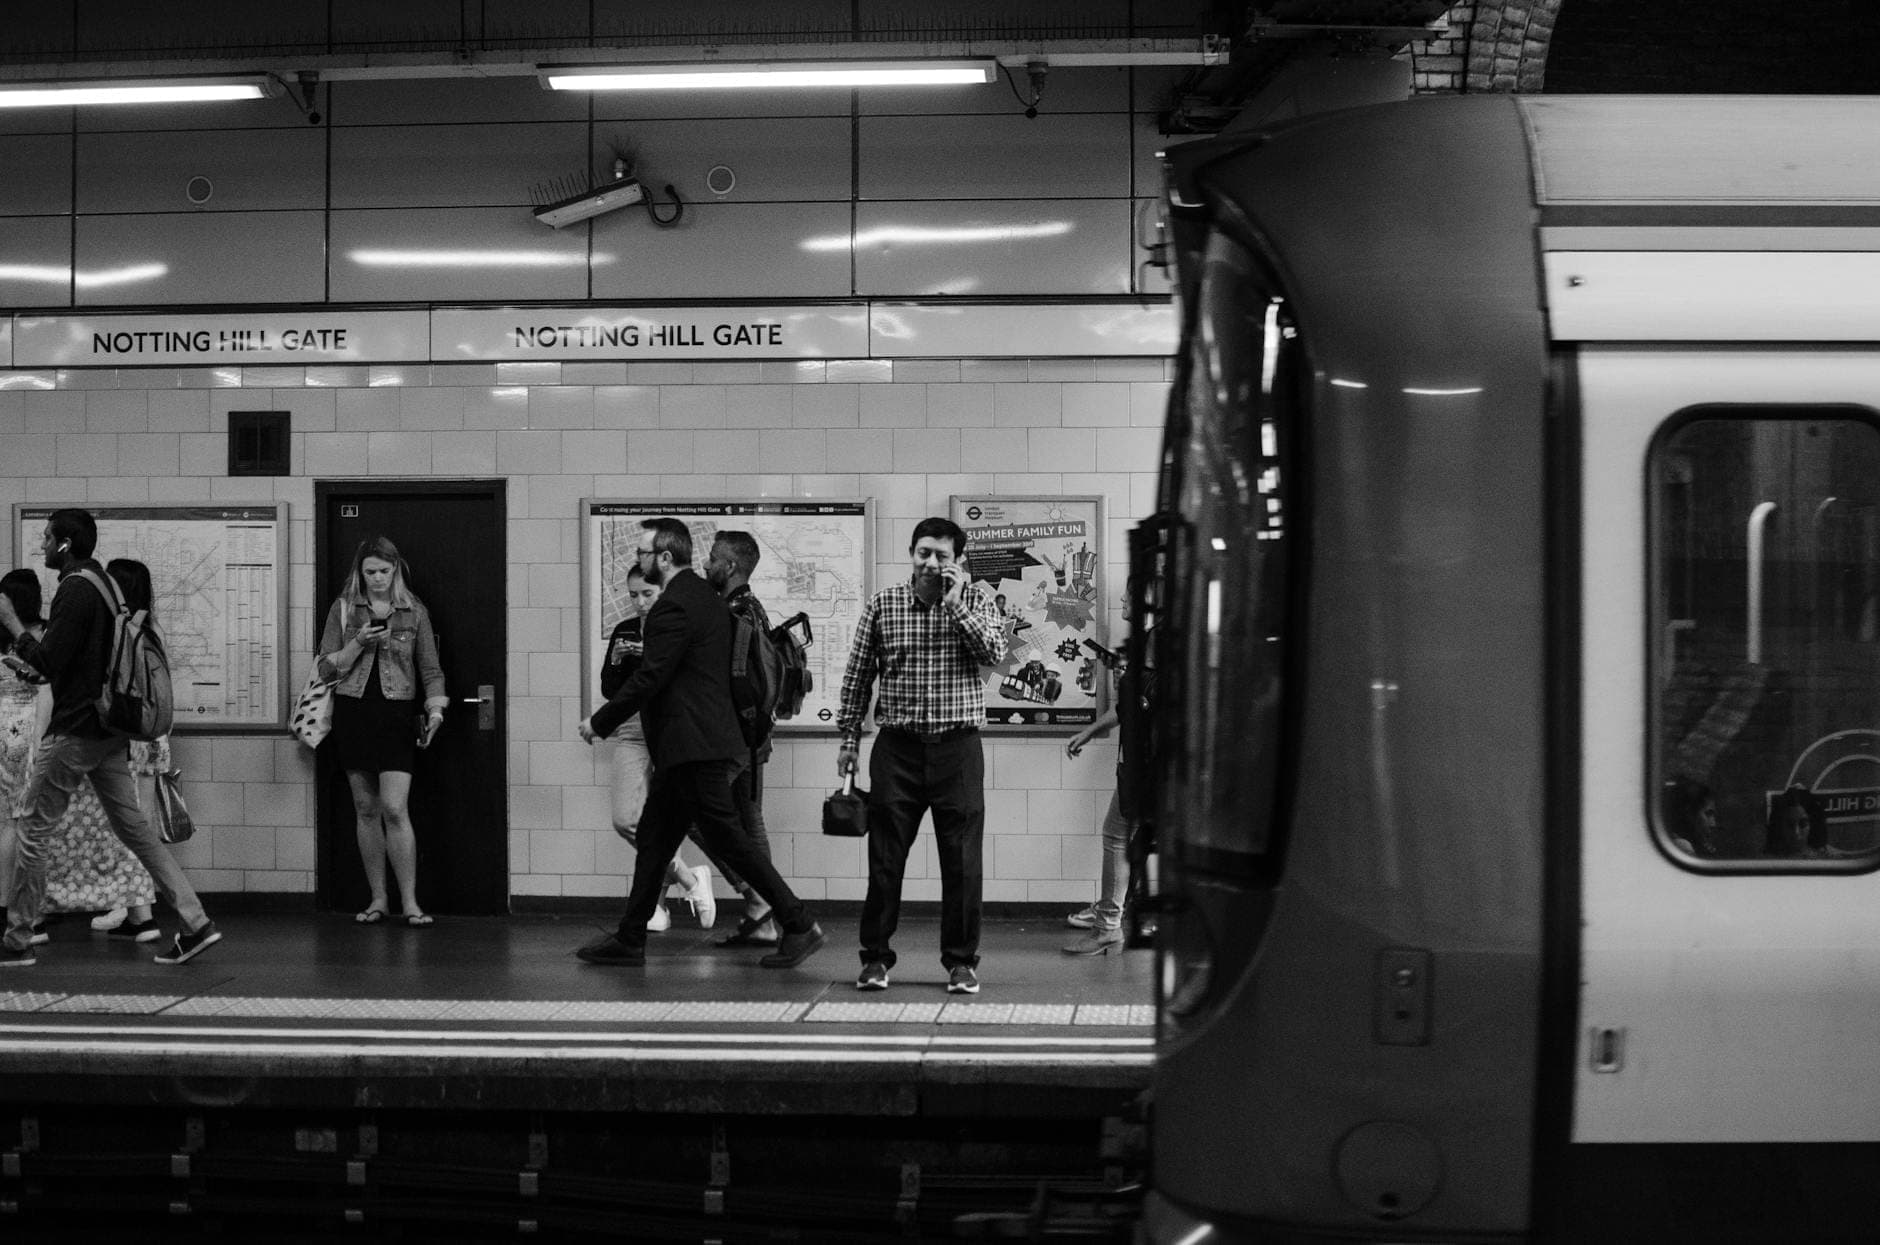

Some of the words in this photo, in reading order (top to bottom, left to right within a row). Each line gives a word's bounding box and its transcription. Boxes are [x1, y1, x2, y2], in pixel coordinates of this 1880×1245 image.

[93, 330, 211, 353] NOTTING
[219, 330, 272, 352] HILL
[281, 328, 348, 351] GATE
[515, 325, 639, 348] NOTTING
[649, 325, 704, 346] HILL
[713, 324, 783, 346] GATE
[966, 528, 1015, 541] SUMMER
[1017, 526, 1055, 538] FAMILY
[1058, 524, 1082, 535] FUN
